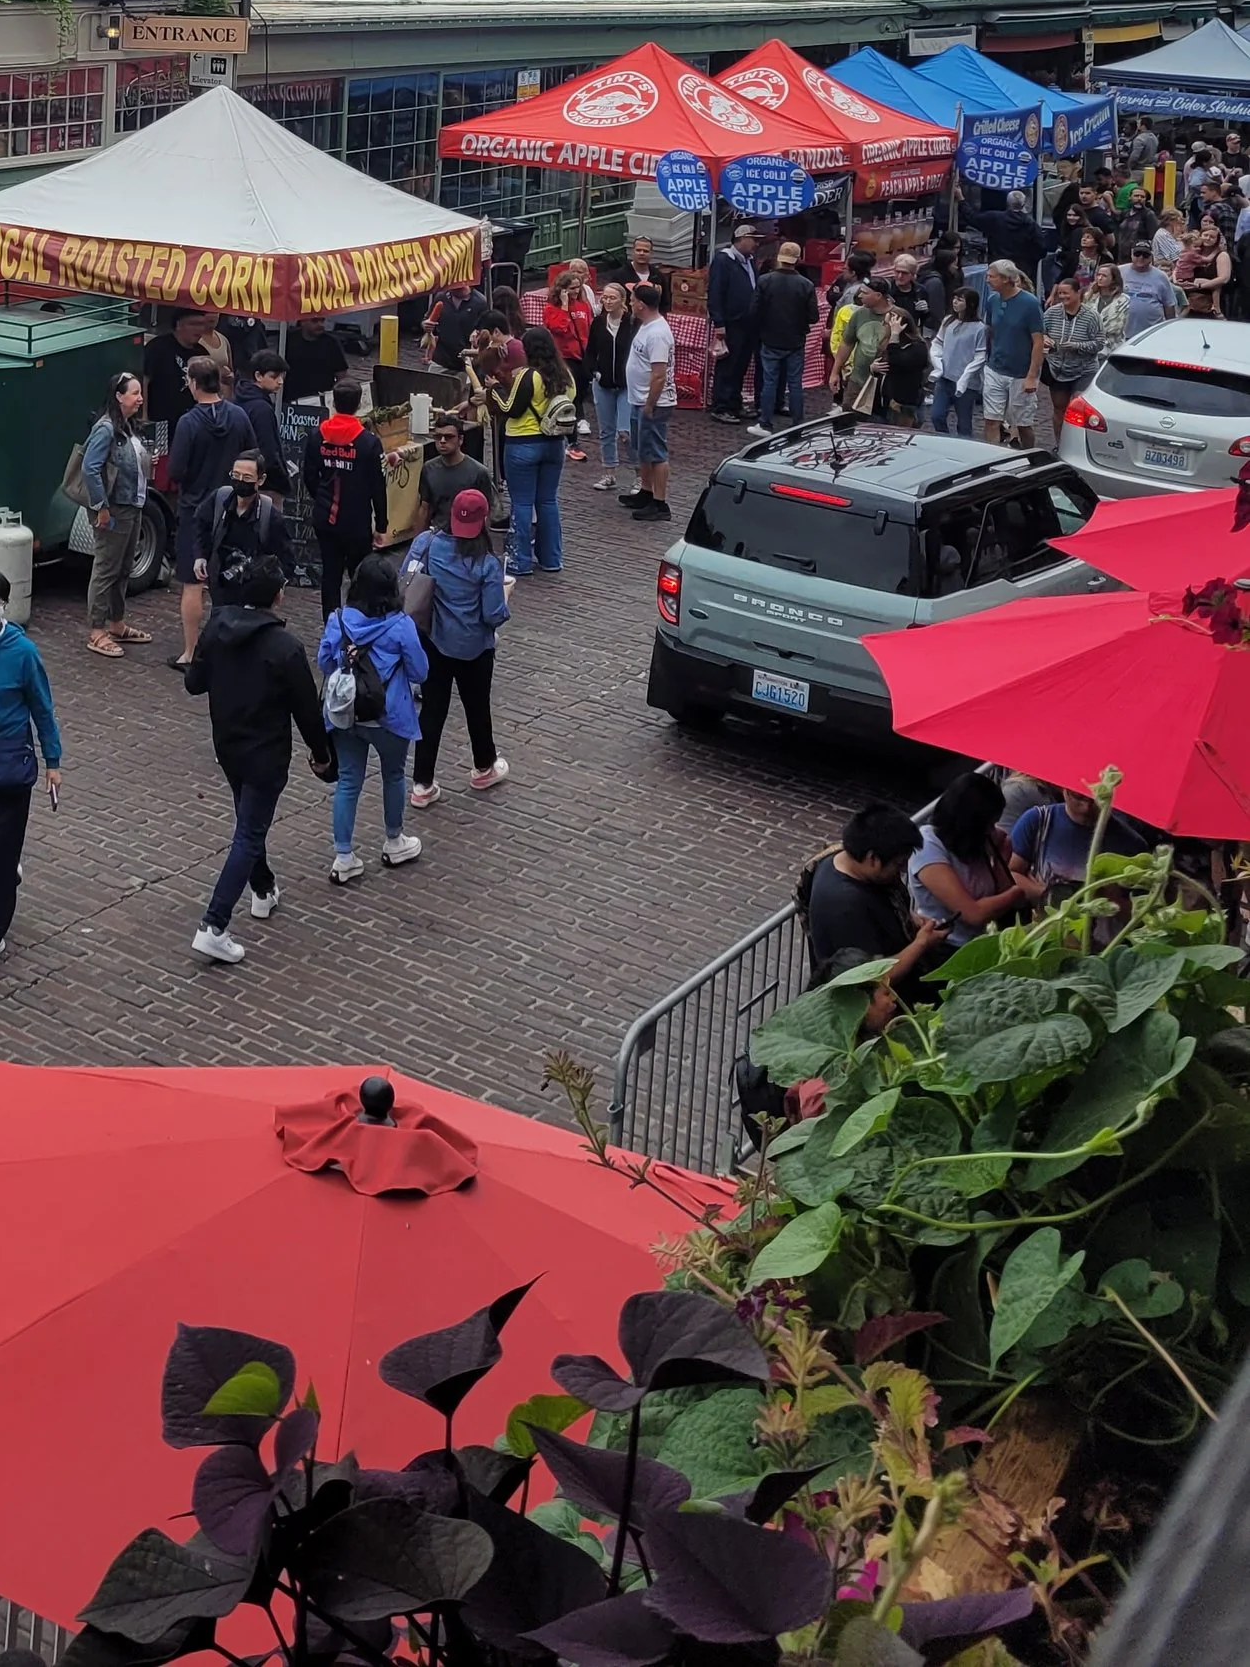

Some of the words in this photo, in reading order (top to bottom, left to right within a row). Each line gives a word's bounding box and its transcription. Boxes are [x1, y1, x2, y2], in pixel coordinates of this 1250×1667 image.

[132, 25, 237, 43] ENTRANCE
[192, 75, 222, 86] Elevator
[1172, 97, 1207, 111] Cider
[568, 110, 630, 125] ORGANIC
[973, 117, 997, 135] Grilled
[997, 117, 1021, 133] Cheese
[981, 138, 1019, 150] ORGANIC
[1070, 126, 1084, 148] Ice
[460, 134, 554, 163] ORGANIC
[557, 142, 623, 172] APPLE
[789, 147, 844, 170] FAMOUS
[862, 139, 902, 165] ORGANIC
[902, 137, 928, 157] APPLE
[980, 147, 992, 156] ICE
[994, 149, 1015, 160] COLD
[746, 157, 789, 168] ORGANIC
[965, 157, 1028, 178] APPLE
[746, 170, 761, 179] ICE
[763, 170, 787, 181] COLD
[964, 169, 1026, 189] CIDER
[667, 178, 708, 192] APPLE
[731, 183, 803, 200] APPLE
[880, 180, 903, 197] PEACH
[904, 176, 925, 194] APPLE
[669, 193, 710, 209] CIDER
[731, 197, 803, 215] CIDER
[809, 187, 843, 209] DER
[58, 236, 186, 301] ROASTED
[189, 251, 275, 315] CORN
[298, 254, 354, 314] LOCAL
[350, 242, 435, 304] ROASTED
[428, 232, 475, 286] CORN
[286, 406, 320, 427] Roasted
[320, 446, 337, 457] Red
[338, 447, 357, 459] Bull
[733, 593, 843, 626] BRONCO
[766, 610, 807, 623] SPORT
[755, 681, 805, 707] CJG1520
